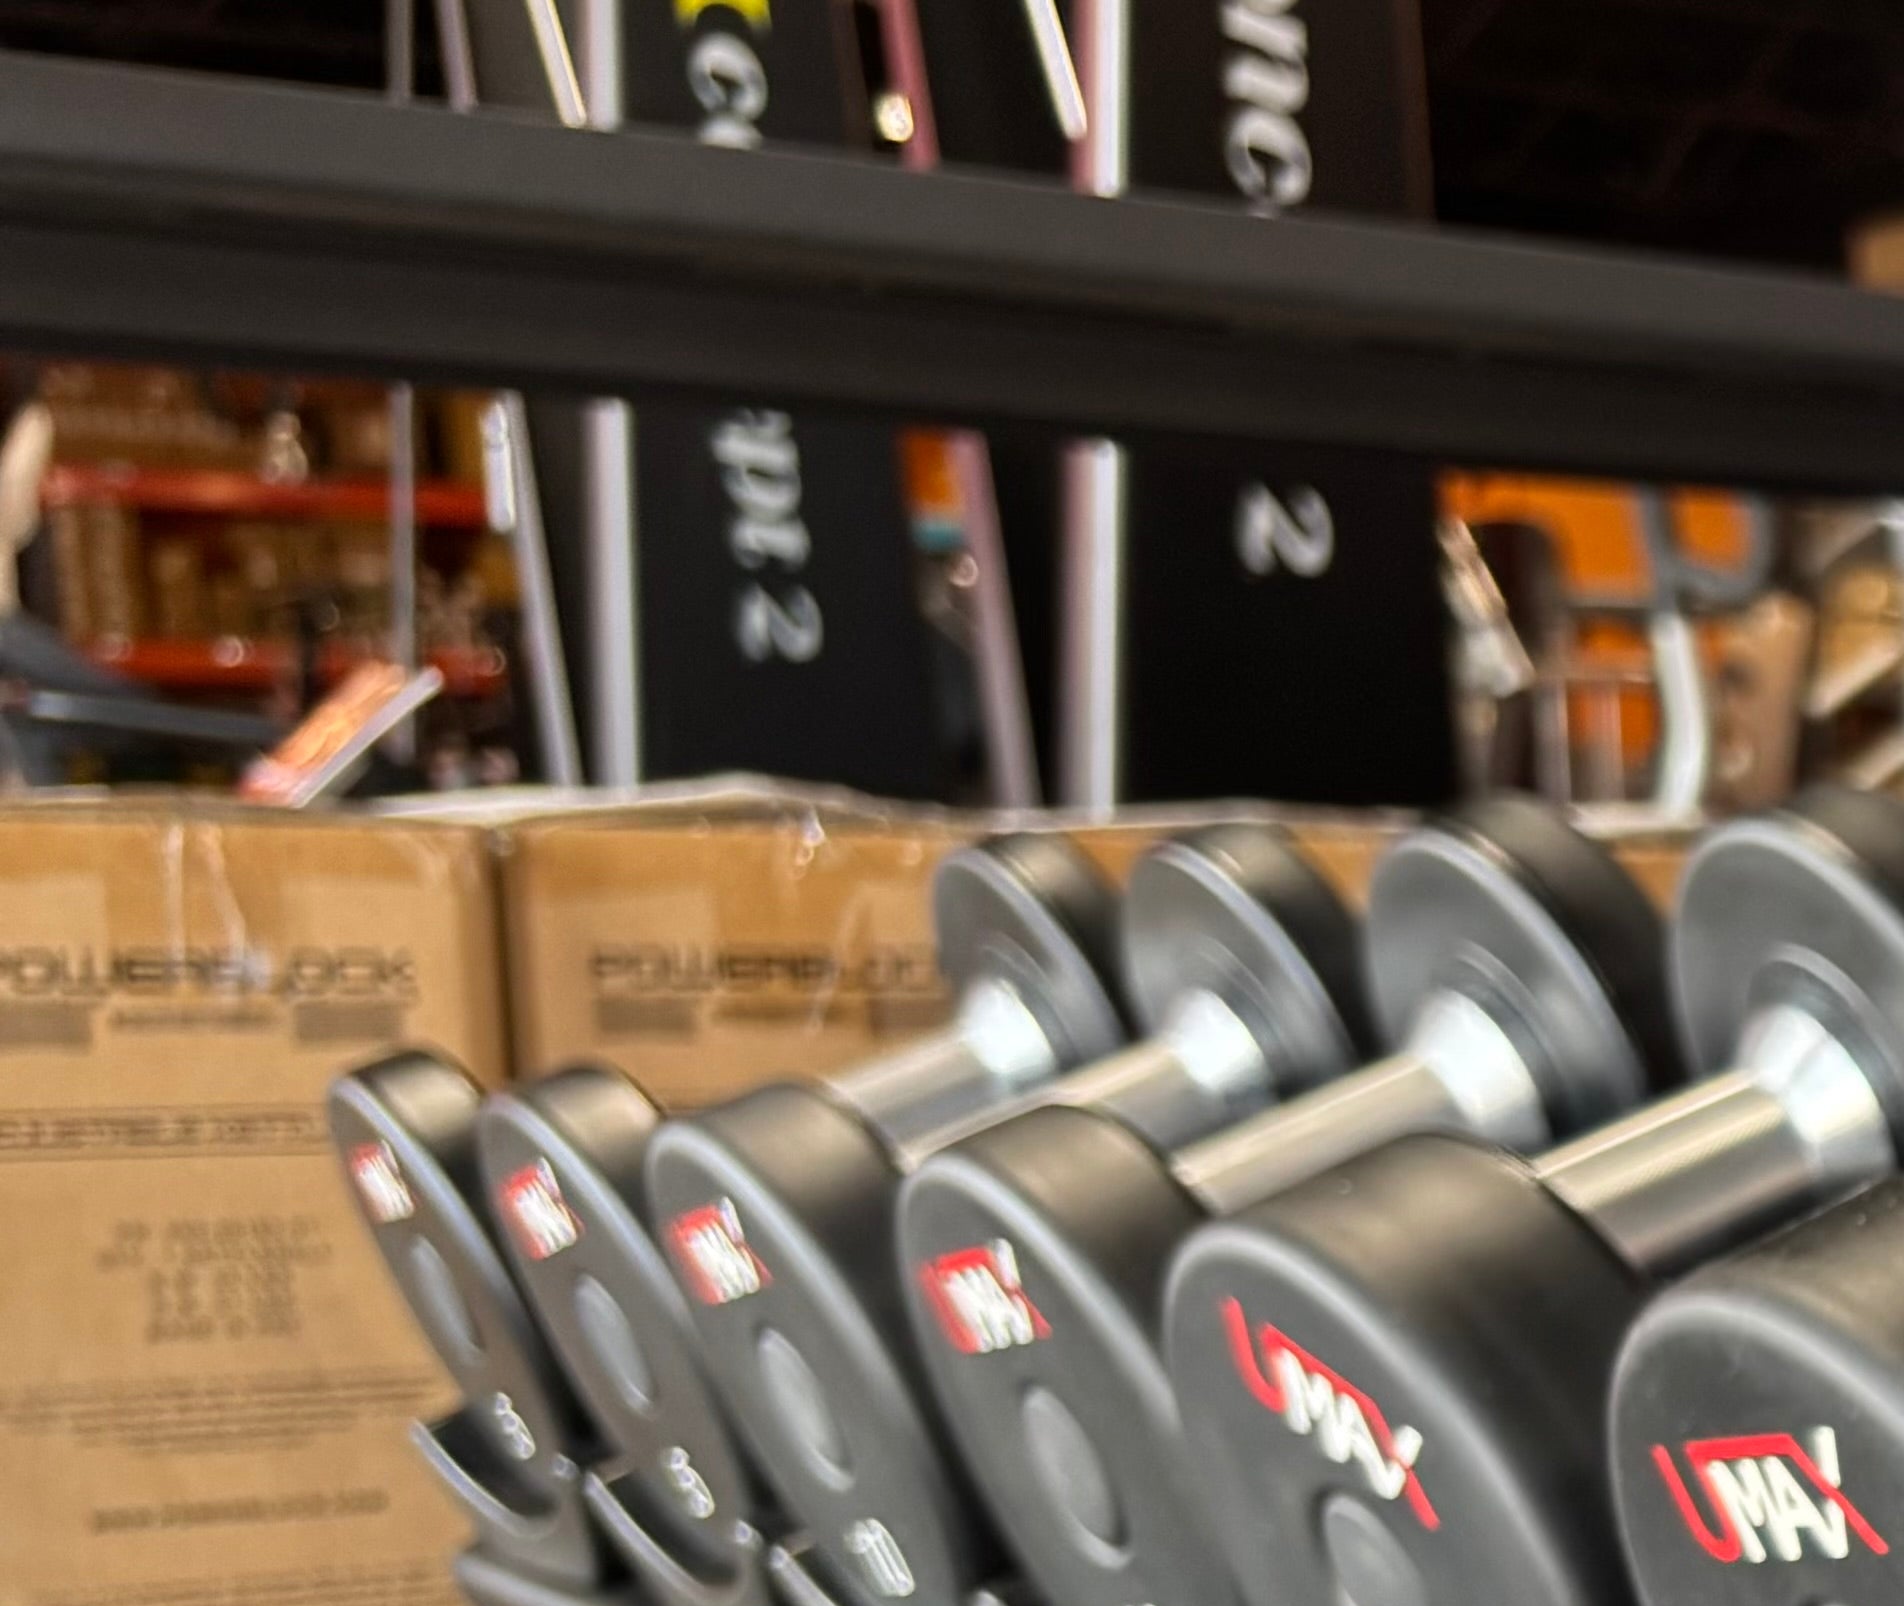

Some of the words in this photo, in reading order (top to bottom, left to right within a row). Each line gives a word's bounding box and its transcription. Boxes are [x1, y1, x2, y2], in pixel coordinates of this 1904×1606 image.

[1235, 482, 1336, 578] 2
[1219, 1295, 1442, 1531] UMAX
[1650, 1424, 1890, 1563] UMAX
